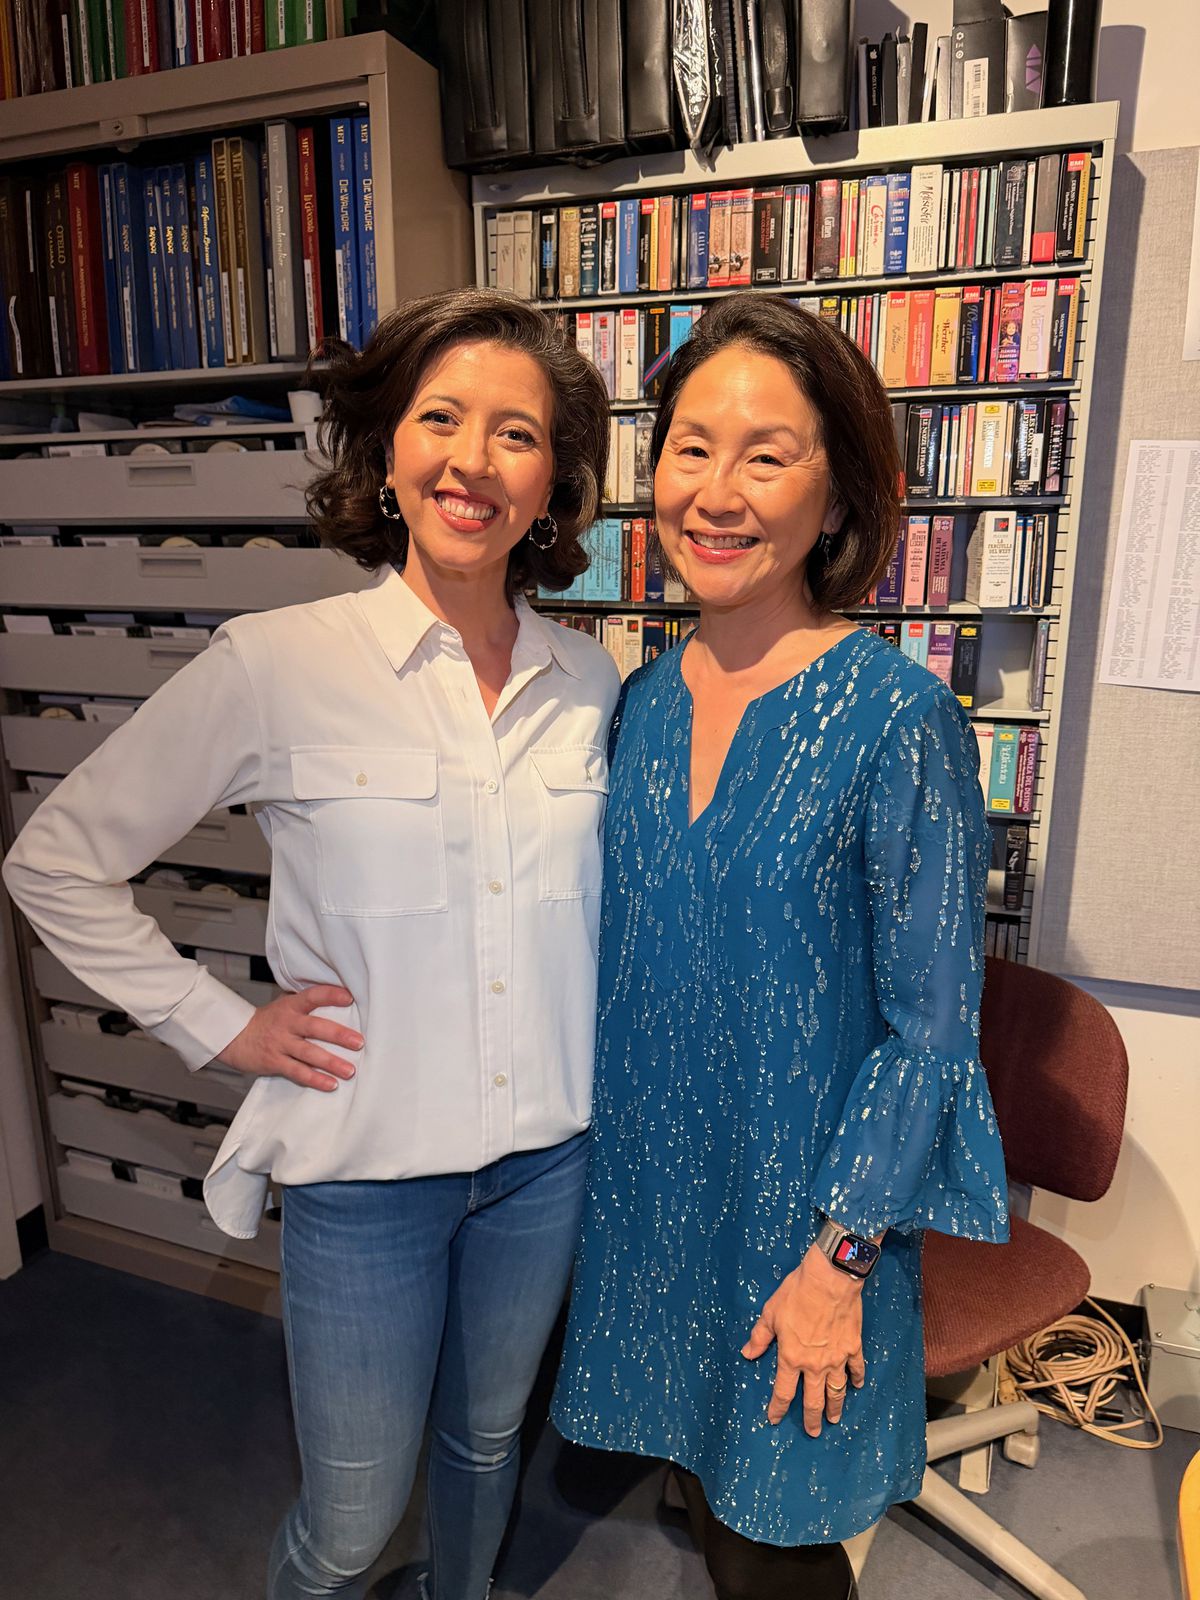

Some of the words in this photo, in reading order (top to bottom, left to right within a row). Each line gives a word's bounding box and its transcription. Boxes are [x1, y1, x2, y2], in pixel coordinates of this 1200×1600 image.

[336, 124, 345, 144] MET
[360, 123, 369, 144] MET
[301, 137, 310, 157] MET
[199, 161, 207, 179] MET
[217, 153, 227, 182] MET
[232, 150, 242, 180] MET
[1069, 159, 1084, 167] EMI
[73, 172, 81, 189] MET
[824, 216, 836, 239] Carmen
[870, 204, 885, 247] Carmen
[697, 231, 706, 256] CALLAS
[940, 319, 951, 354] Werther
[1029, 304, 1046, 353] Manon
[1058, 313, 1066, 338] MASSENET
[922, 418, 928, 427] LE
[1029, 413, 1037, 427] LES
[920, 446, 926, 454] DI
[1026, 427, 1036, 457] CONTES
[933, 537, 942, 576] BUTTERFLY
[939, 541, 948, 571] MADAMA
[889, 561, 900, 593] Lescaut
[1028, 743, 1036, 752] LA
[1026, 753, 1035, 774] FORZA
[1022, 787, 1031, 812] DESTINO
